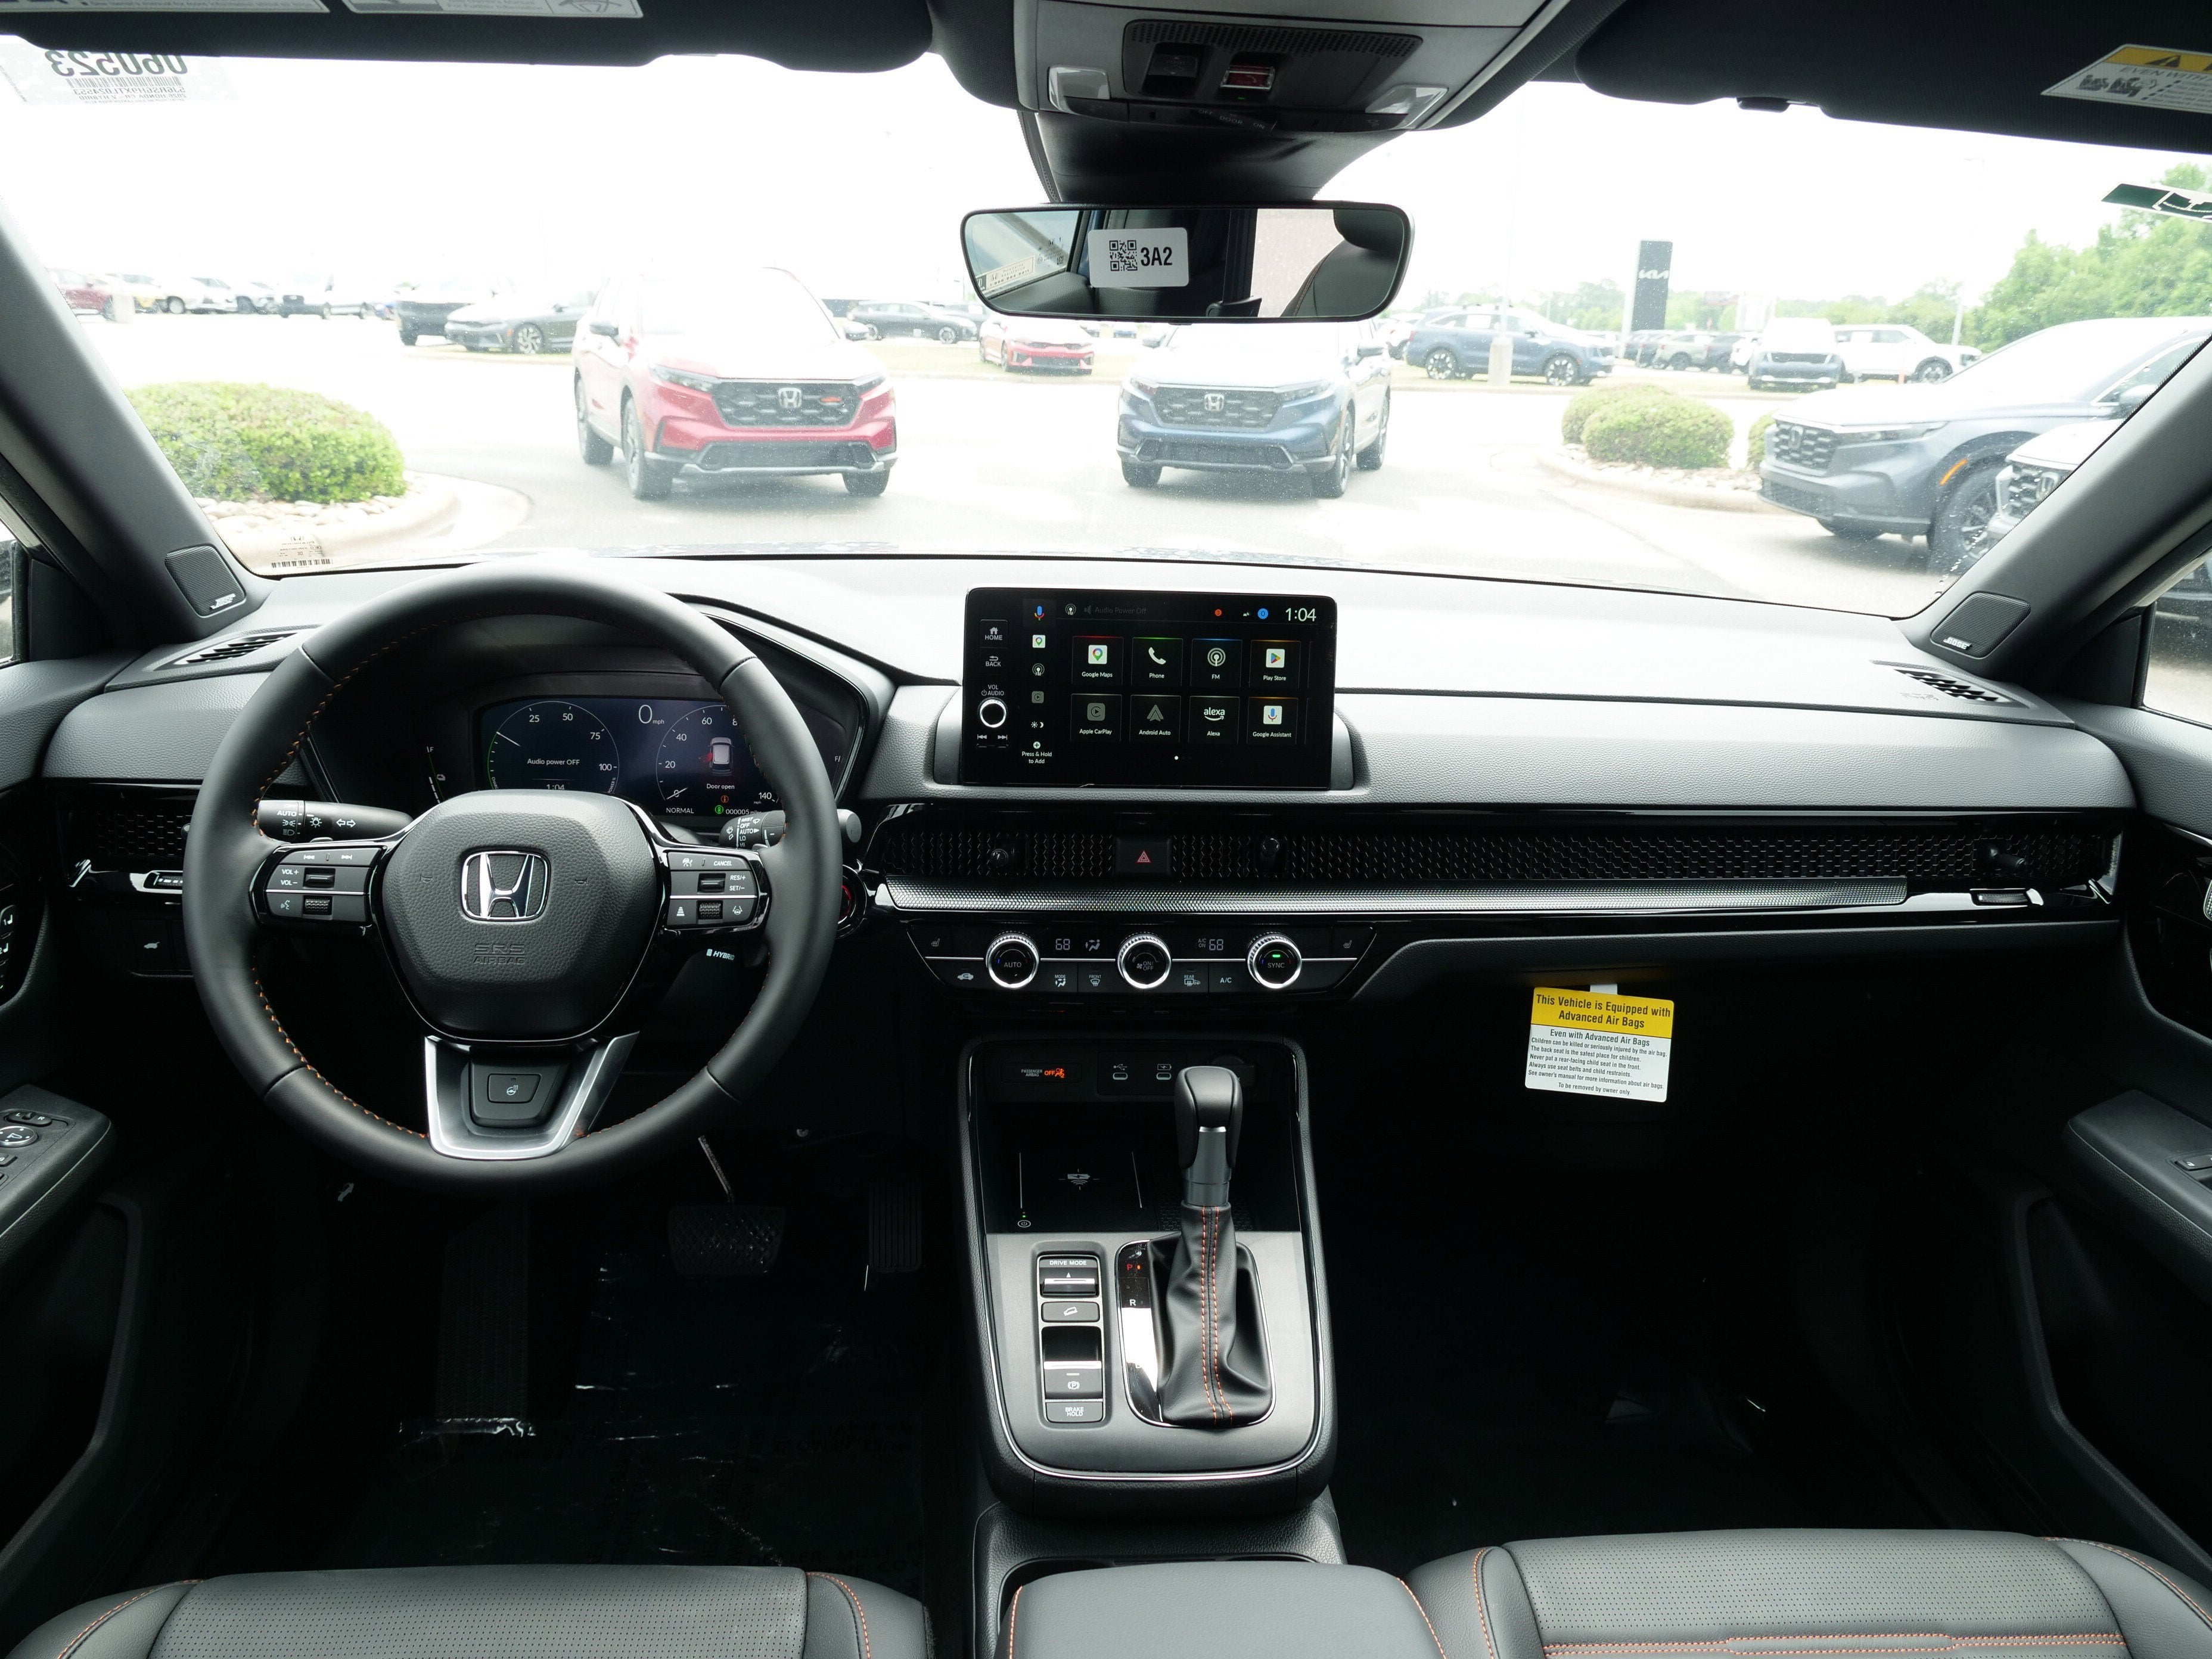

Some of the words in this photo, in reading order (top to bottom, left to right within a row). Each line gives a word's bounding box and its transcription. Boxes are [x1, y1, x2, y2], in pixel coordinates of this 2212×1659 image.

[1220, 115, 1244, 125] DOOR
[1141, 246, 1172, 266] 3A2
[1285, 607, 1316, 622] 1:04
[638, 704, 653, 724] 0
[1204, 707, 1225, 716] alexa
[590, 732, 600, 740] 75
[474, 943, 526, 954] SRS
[1055, 939, 1070, 950] 68
[1208, 939, 1223, 950] 68
[473, 956, 526, 965] AIRBAG
[713, 950, 735, 961] HYBRID
[1536, 994, 1555, 1005] This
[1558, 996, 1592, 1009] Vehicle
[1595, 1001, 1602, 1011] is
[1605, 1001, 1648, 1015] Equipped
[1651, 1006, 1670, 1017] with
[1558, 1010, 1603, 1024] Advanced
[1605, 1015, 1619, 1025] Air
[1622, 1017, 1645, 1029] Bags
[1550, 1029, 1567, 1038] Even
[1568, 1030, 1583, 1039] with
[1585, 1033, 1618, 1043] Advanced
[1620, 1036, 1631, 1045] Air
[1633, 1037, 1650, 1047] Bags
[1590, 1043, 1613, 1052] seriously
[1613, 1045, 1631, 1054] injured
[1558, 1057, 1586, 1065] rear-facing
[1596, 1051, 1610, 1060] place
[1528, 1061, 1546, 1070] Always
[1607, 1068, 1632, 1077] restraints.
[1598, 1076, 1627, 1085] information
[1619, 1088, 1631, 1096] only.
